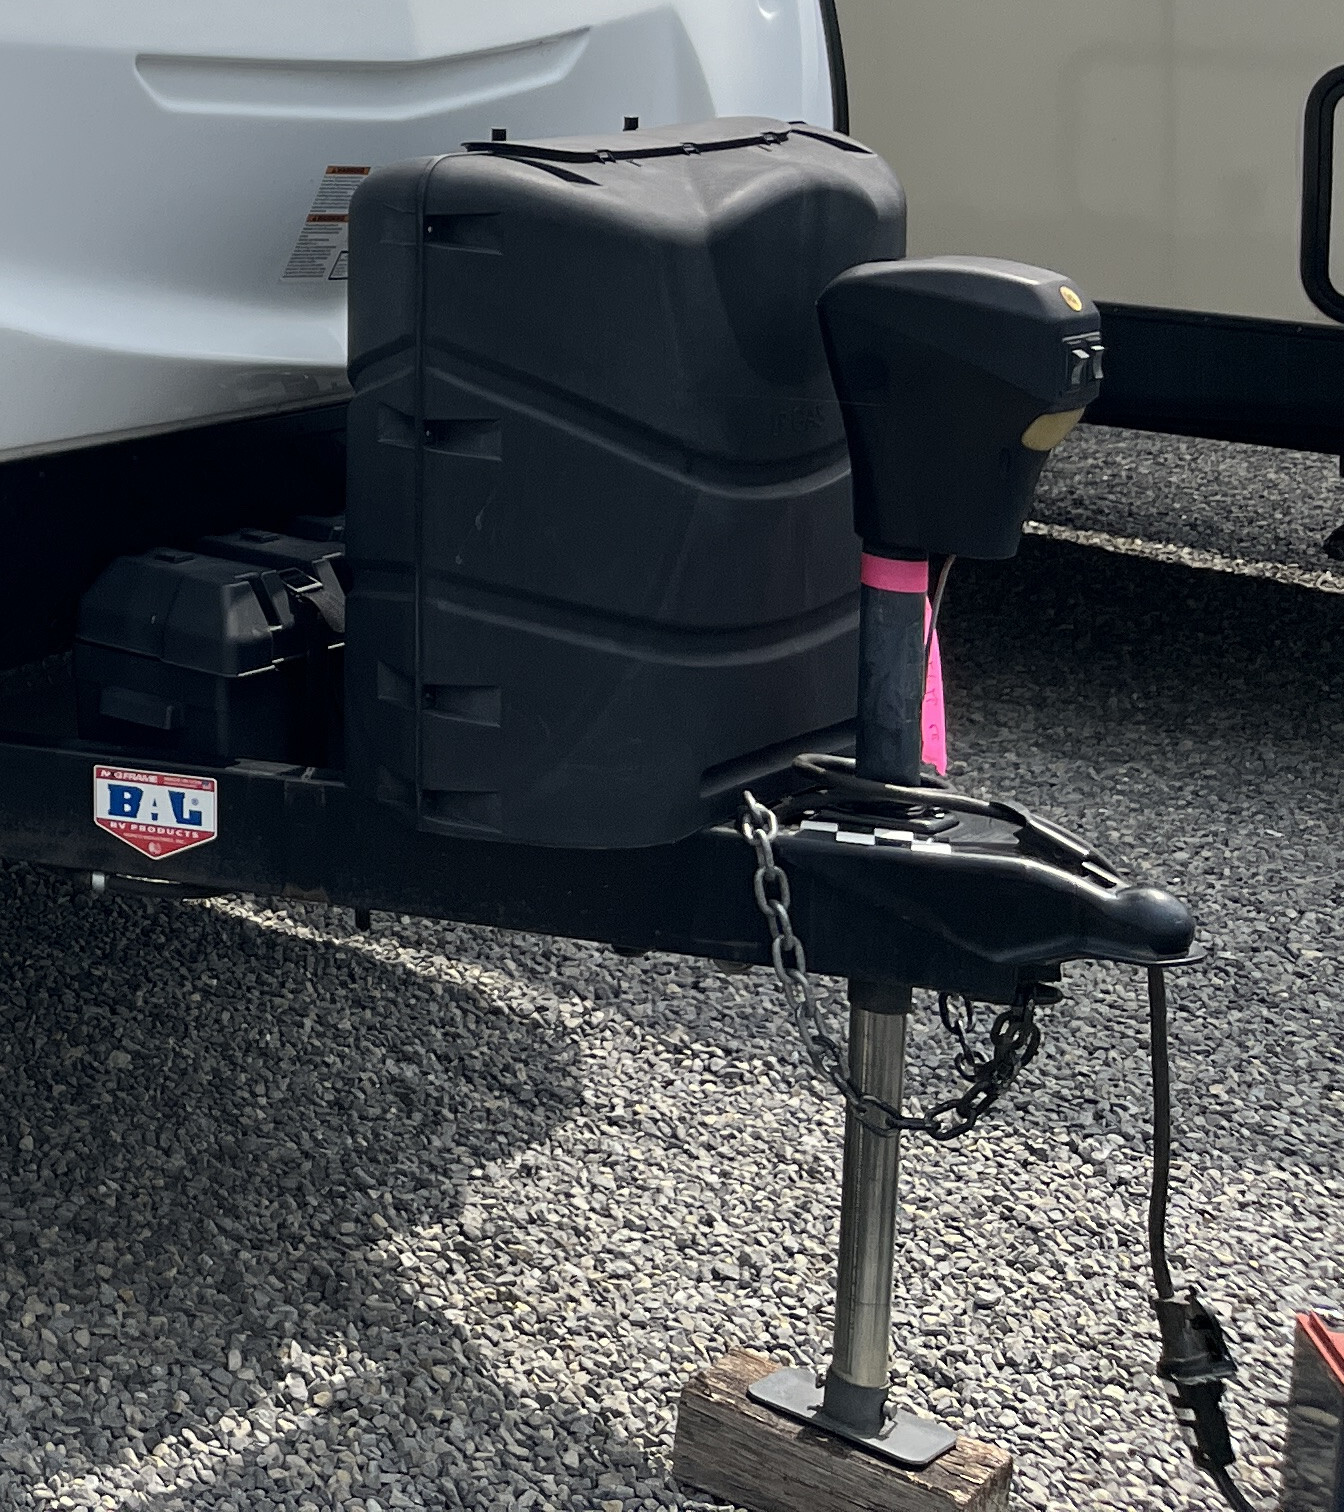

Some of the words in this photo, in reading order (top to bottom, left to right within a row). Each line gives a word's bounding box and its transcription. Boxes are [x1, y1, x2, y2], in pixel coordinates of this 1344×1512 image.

[107, 783, 202, 827] BAL
[110, 821, 126, 830] RV
[130, 824, 199, 839] PRODUCTS
